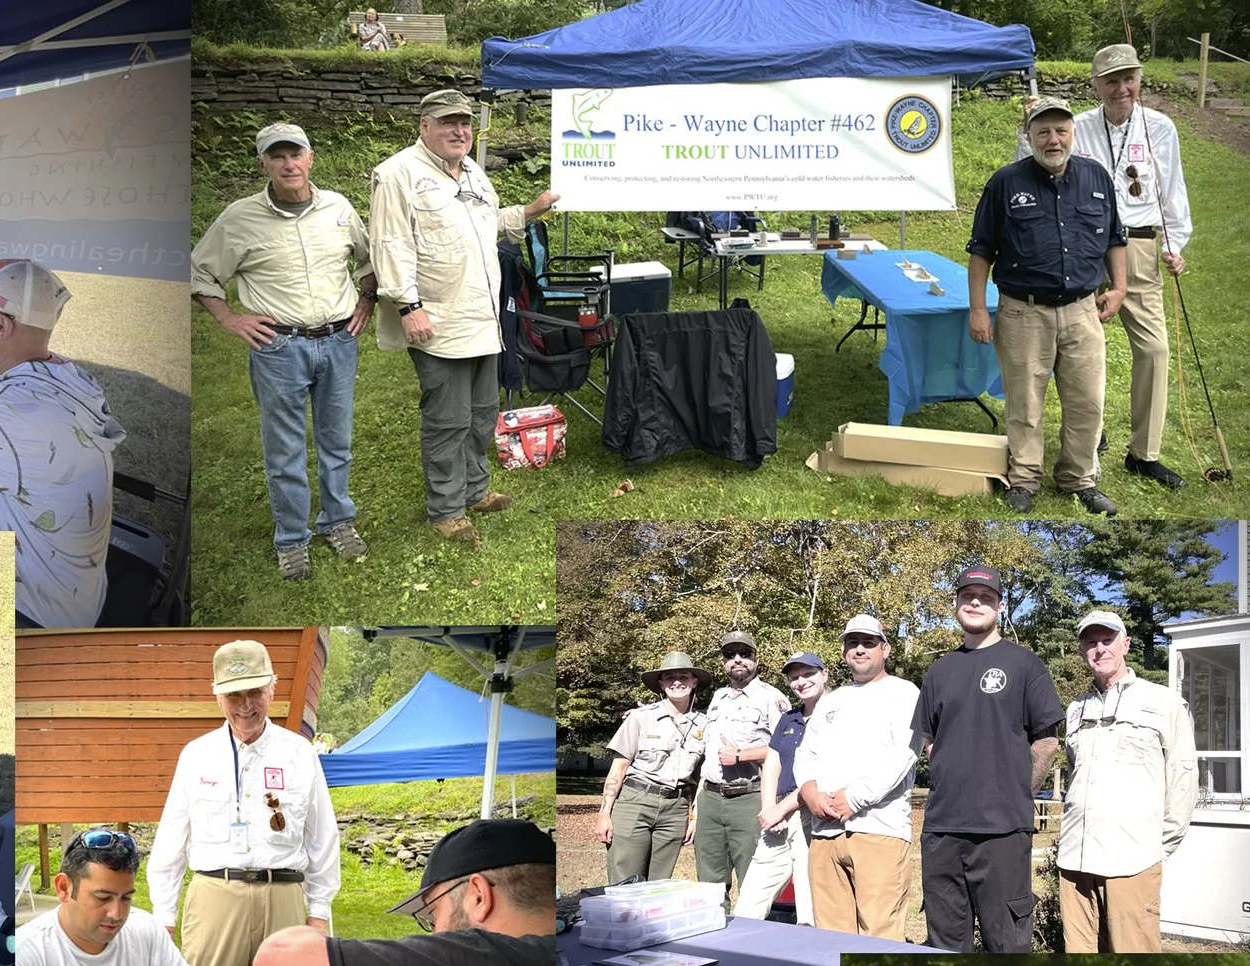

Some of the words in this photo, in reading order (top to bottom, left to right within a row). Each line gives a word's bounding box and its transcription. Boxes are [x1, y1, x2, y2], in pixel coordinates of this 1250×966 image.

[623, 114, 664, 132] Pike
[684, 114, 747, 136] Wayne
[753, 114, 826, 136] Chapter
[830, 114, 876, 132] #462
[562, 143, 616, 160] TROUT
[662, 145, 729, 160] TROUT
[735, 144, 839, 160] UNLIMITED
[624, 174, 658, 183] protecting,
